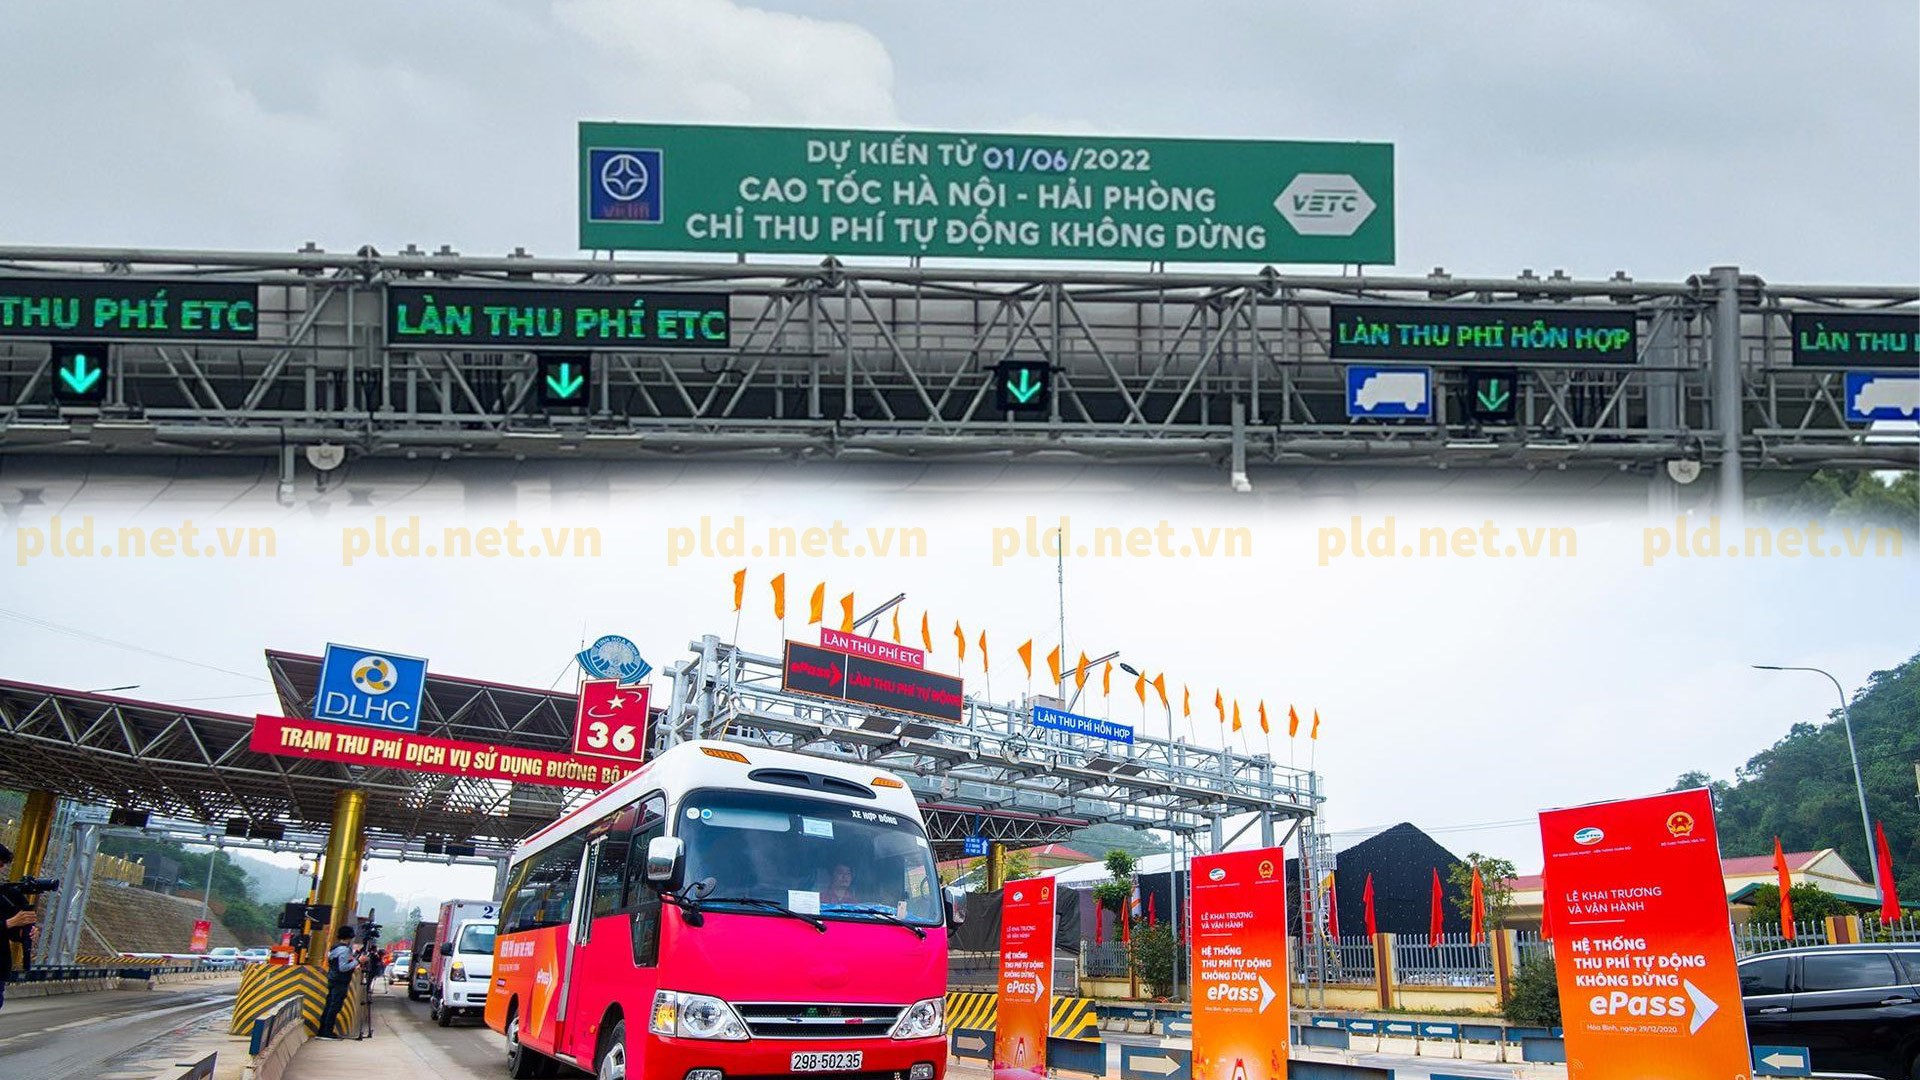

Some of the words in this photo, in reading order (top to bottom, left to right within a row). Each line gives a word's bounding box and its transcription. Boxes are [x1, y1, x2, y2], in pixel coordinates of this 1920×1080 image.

[807, 140, 851, 169] DỰ
[860, 135, 928, 165] KIẾN
[938, 139, 978, 166] TỪ
[982, 146, 1151, 171] 01/06/2022
[740, 177, 807, 202] CAO
[817, 170, 882, 205] TỐC
[893, 175, 938, 206] HÀ
[948, 176, 1006, 212] NỘI
[1039, 177, 1091, 210] HẢI
[1103, 180, 1216, 212] PHÒNG
[1291, 195, 1358, 213] VETC
[686, 206, 743, 240] CHỈ
[754, 215, 820, 241] THU
[830, 210, 886, 242] PHÍ
[895, 218, 938, 250] TỰ
[946, 207, 1039, 251] ĐỘNG
[1051, 216, 1166, 248] KHÔNG
[1176, 219, 1266, 250] DỪNG
[0, 296, 79, 329] THU
[94, 288, 168, 330] PHÍ
[181, 301, 254, 331] ETC
[397, 294, 472, 335] LÀN
[483, 306, 562, 337] THU
[575, 299, 646, 338] PHÍ
[657, 310, 726, 339] ETC
[1339, 316, 1390, 346] LÀN
[1396, 324, 1449, 347] THU
[1457, 320, 1505, 348] PHÍ
[1801, 322, 1849, 350] LÀN
[1856, 332, 1907, 351] THU
[823, 632, 849, 649] LÀN
[851, 639, 876, 655] THU
[878, 645, 898, 660] PHÍ
[900, 650, 921, 664] ETC
[325, 691, 411, 724] DLHC
[586, 721, 637, 752] 36
[1038, 711, 1057, 724] LÀN
[1058, 716, 1076, 728] THU
[1078, 719, 1093, 732] PHÍ
[1113, 727, 1131, 739] HỢP
[280, 726, 331, 753] TRẠM
[336, 733, 368, 755] THU
[372, 737, 402, 759] PHÍ
[406, 744, 445, 767] DỊCH
[449, 748, 471, 771] VỤ
[474, 746, 498, 770] SỬ
[499, 753, 542, 778] DỤNG
[547, 757, 598, 783] ĐƯỜNG
[850, 809, 862, 819] XE
[1566, 889, 1579, 903] LỄ
[1582, 890, 1608, 901] KHAI
[1610, 886, 1662, 900] TRƯƠNG
[1567, 904, 1582, 915] VÀ
[1585, 902, 1608, 917] VẬN
[1611, 899, 1645, 911] HÀNH
[1572, 937, 1590, 955] HỆ
[1593, 935, 1646, 951] THỐNG
[1201, 959, 1217, 968] THU
[1219, 957, 1232, 968] PHÍ
[1574, 957, 1602, 969] THU
[1606, 953, 1631, 969] PHÍ
[1633, 955, 1655, 972] TỰ
[1658, 952, 1706, 972] ĐỘNG
[1006, 980, 1036, 994] ePass
[1207, 983, 1259, 1001] ePass
[1576, 972, 1629, 987] KHÔNG
[1632, 973, 1679, 987] DỪNG
[1589, 991, 1687, 1017] ePass
